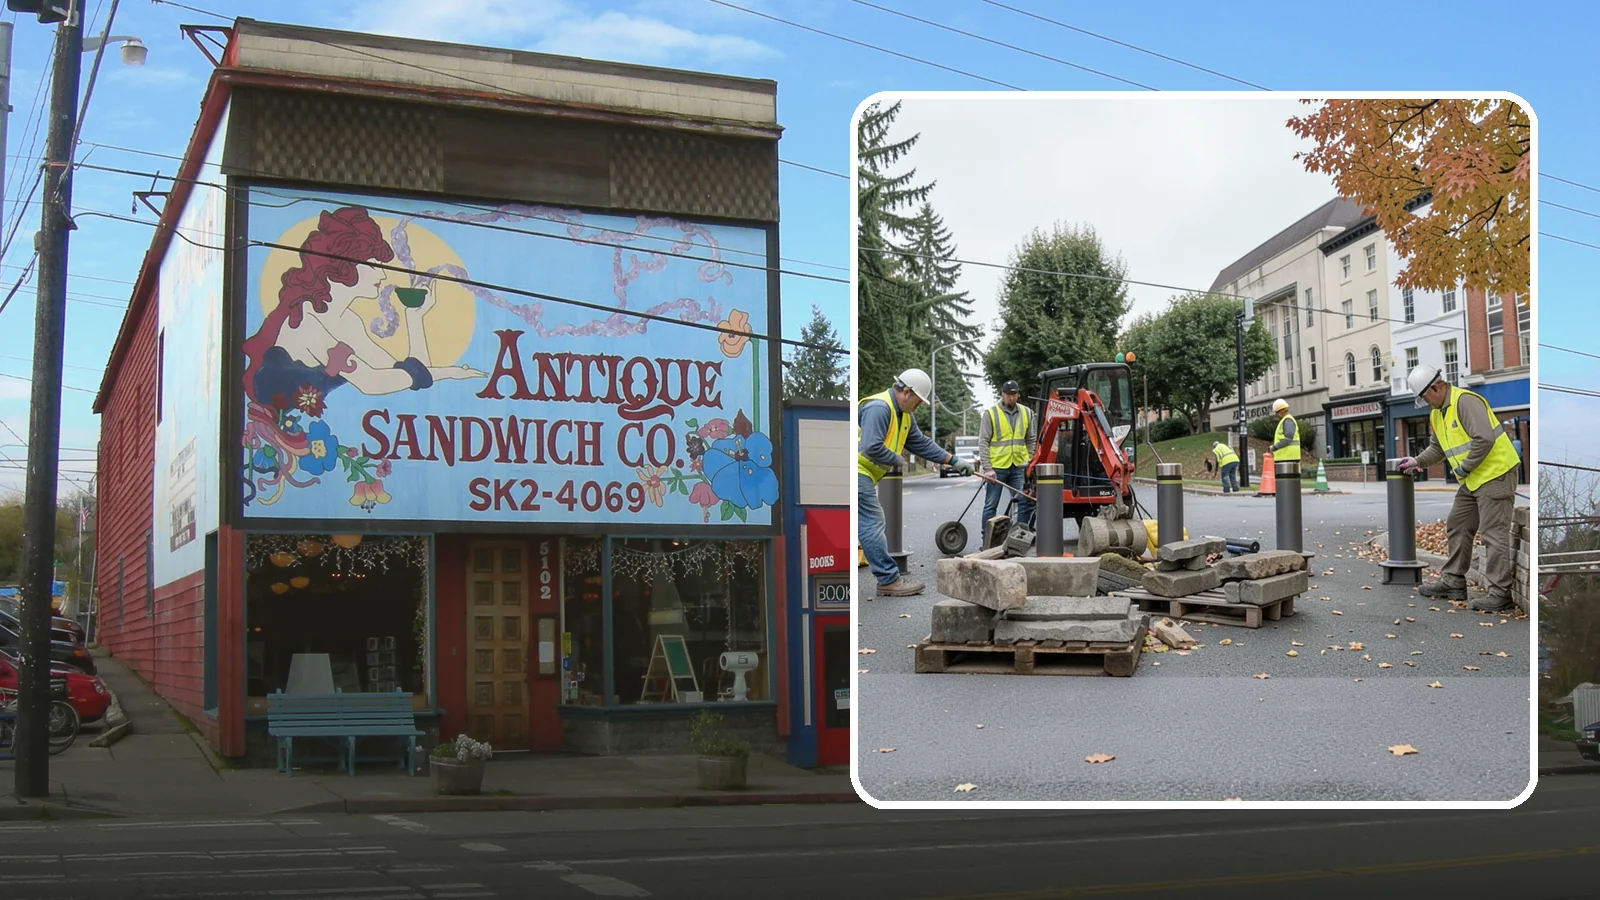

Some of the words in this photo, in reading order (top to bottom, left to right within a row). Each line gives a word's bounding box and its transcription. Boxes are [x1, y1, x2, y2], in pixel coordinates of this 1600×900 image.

[475, 329, 723, 421] ANTIQUE
[361, 408, 605, 467] SANDWICH
[617, 422, 685, 468] CO.
[468, 476, 646, 513] SK2-4069
[540, 541, 552, 600] 5102
[809, 555, 834, 568] BOOKS
